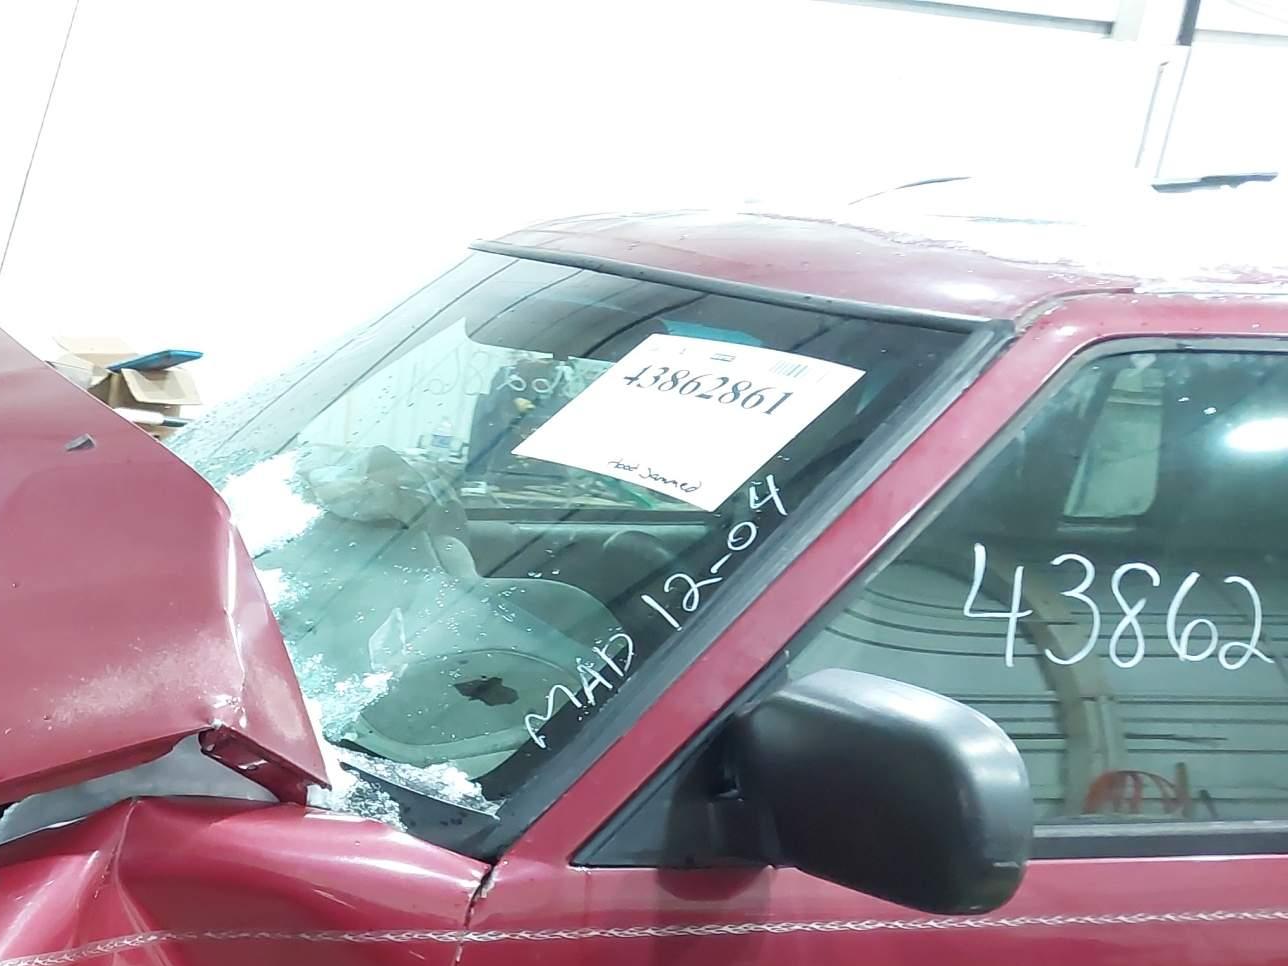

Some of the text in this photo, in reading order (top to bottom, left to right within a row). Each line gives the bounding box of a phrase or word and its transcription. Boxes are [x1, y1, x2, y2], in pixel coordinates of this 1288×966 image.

[622, 364, 795, 418] 43862861
[524, 473, 788, 749] MAD 12-04
[963, 542, 1276, 671] 43862
